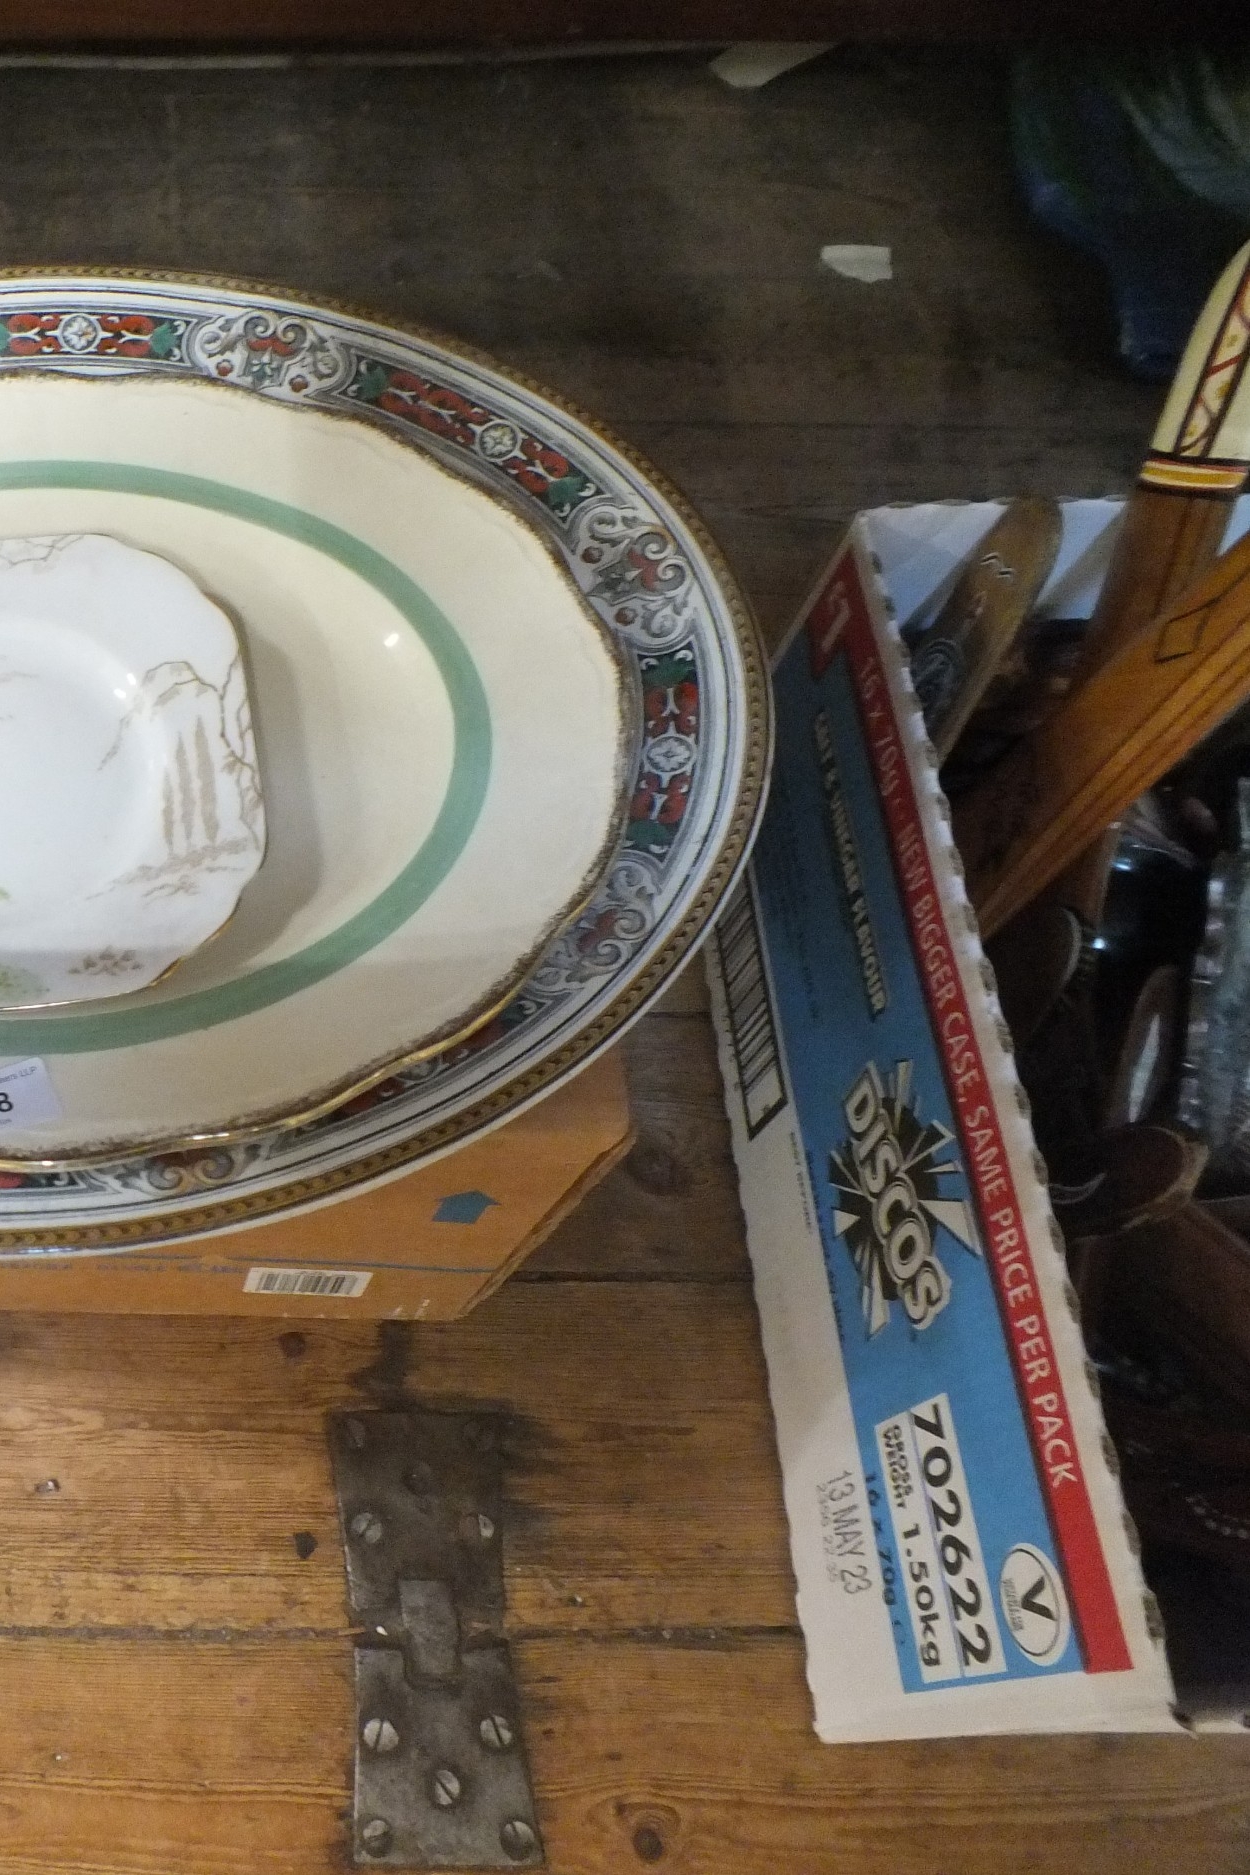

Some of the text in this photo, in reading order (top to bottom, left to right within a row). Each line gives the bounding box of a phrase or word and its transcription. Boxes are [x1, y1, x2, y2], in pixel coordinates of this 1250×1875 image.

[898, 822, 928, 892] NEW
[851, 896, 887, 1013] FLAVOUR
[912, 893, 957, 1010] BIGGER
[942, 1011, 981, 1103] CASE,
[844, 1062, 951, 1329] DISCOS
[965, 1105, 1008, 1202] SAME
[988, 1206, 1031, 1308] PRICE
[1013, 1313, 1051, 1384] PER
[883, 1427, 907, 1509] WEIGHT
[893, 1424, 913, 1496] GROSS
[1032, 1392, 1078, 1489] PACK
[828, 1470, 873, 1595] 13 MAY 23
[910, 1402, 992, 1667] 702622
[902, 1522, 941, 1668] 1.50kg
[1021, 1575, 1057, 1622] V
